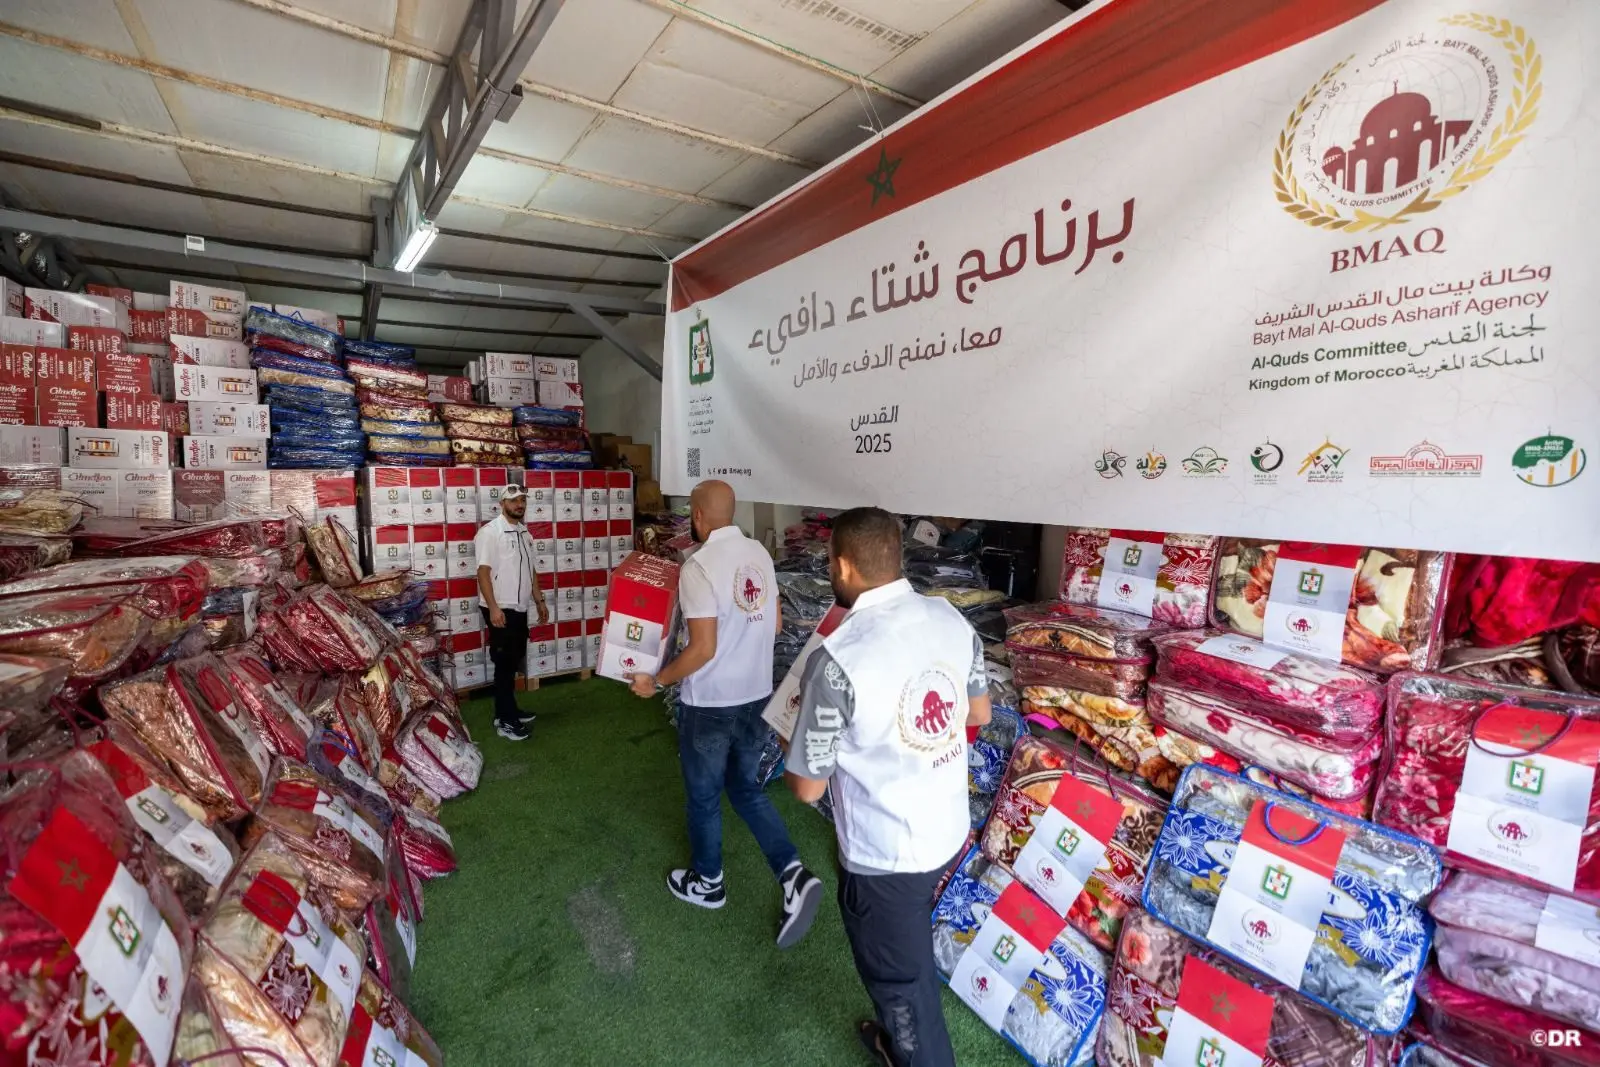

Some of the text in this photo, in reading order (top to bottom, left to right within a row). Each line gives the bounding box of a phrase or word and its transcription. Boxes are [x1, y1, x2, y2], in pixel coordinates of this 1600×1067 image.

[1443, 39, 1468, 51] BAYT
[1466, 45, 1483, 60] MAL
[1486, 65, 1499, 88] QUDS
[1451, 129, 1483, 167] AGENCY
[1338, 177, 1434, 207] AL QUDS COMMITTEE
[1329, 227, 1448, 273] BMAQ
[748, 197, 1135, 366] برنامج شتاء دافيء
[1254, 264, 1552, 327] وكالة بيت مال القدس الشريف
[1253, 289, 1549, 346] Bayt Mal Al-Quds Asharif Agency
[1408, 312, 1546, 357] لجنة القدس
[842, 344, 893, 375] الدفء
[898, 336, 946, 370] نمنح
[1251, 340, 1408, 371] Al-Quds Committee
[1407, 345, 1544, 380] المملكة المغربية
[793, 358, 838, 388] والأمل
[1249, 364, 1406, 391] Kingdom of Morocco
[851, 405, 899, 431] القدس
[855, 433, 892, 454] 2025
[931, 742, 963, 770] BMAQ
